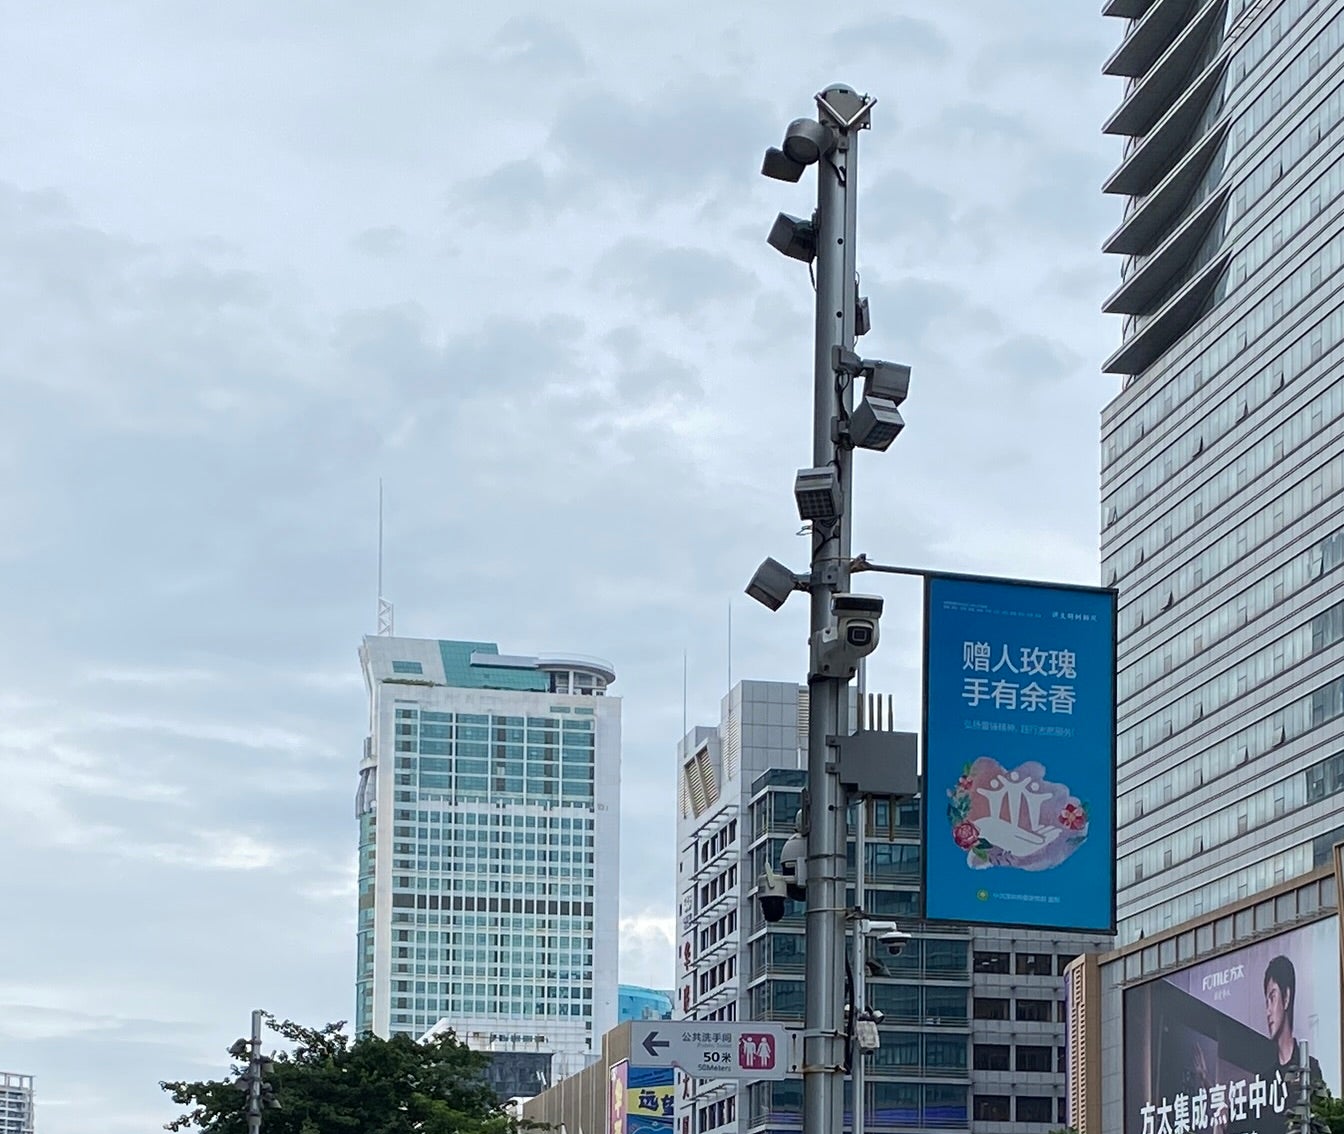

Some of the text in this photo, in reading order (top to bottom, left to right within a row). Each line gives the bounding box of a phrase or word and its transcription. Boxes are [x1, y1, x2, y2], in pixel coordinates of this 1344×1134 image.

[962, 641, 1077, 679] 赠人玫瑰
[962, 677, 1077, 715] 手有余香
[682, 1031, 732, 1043] 公共洗手间
